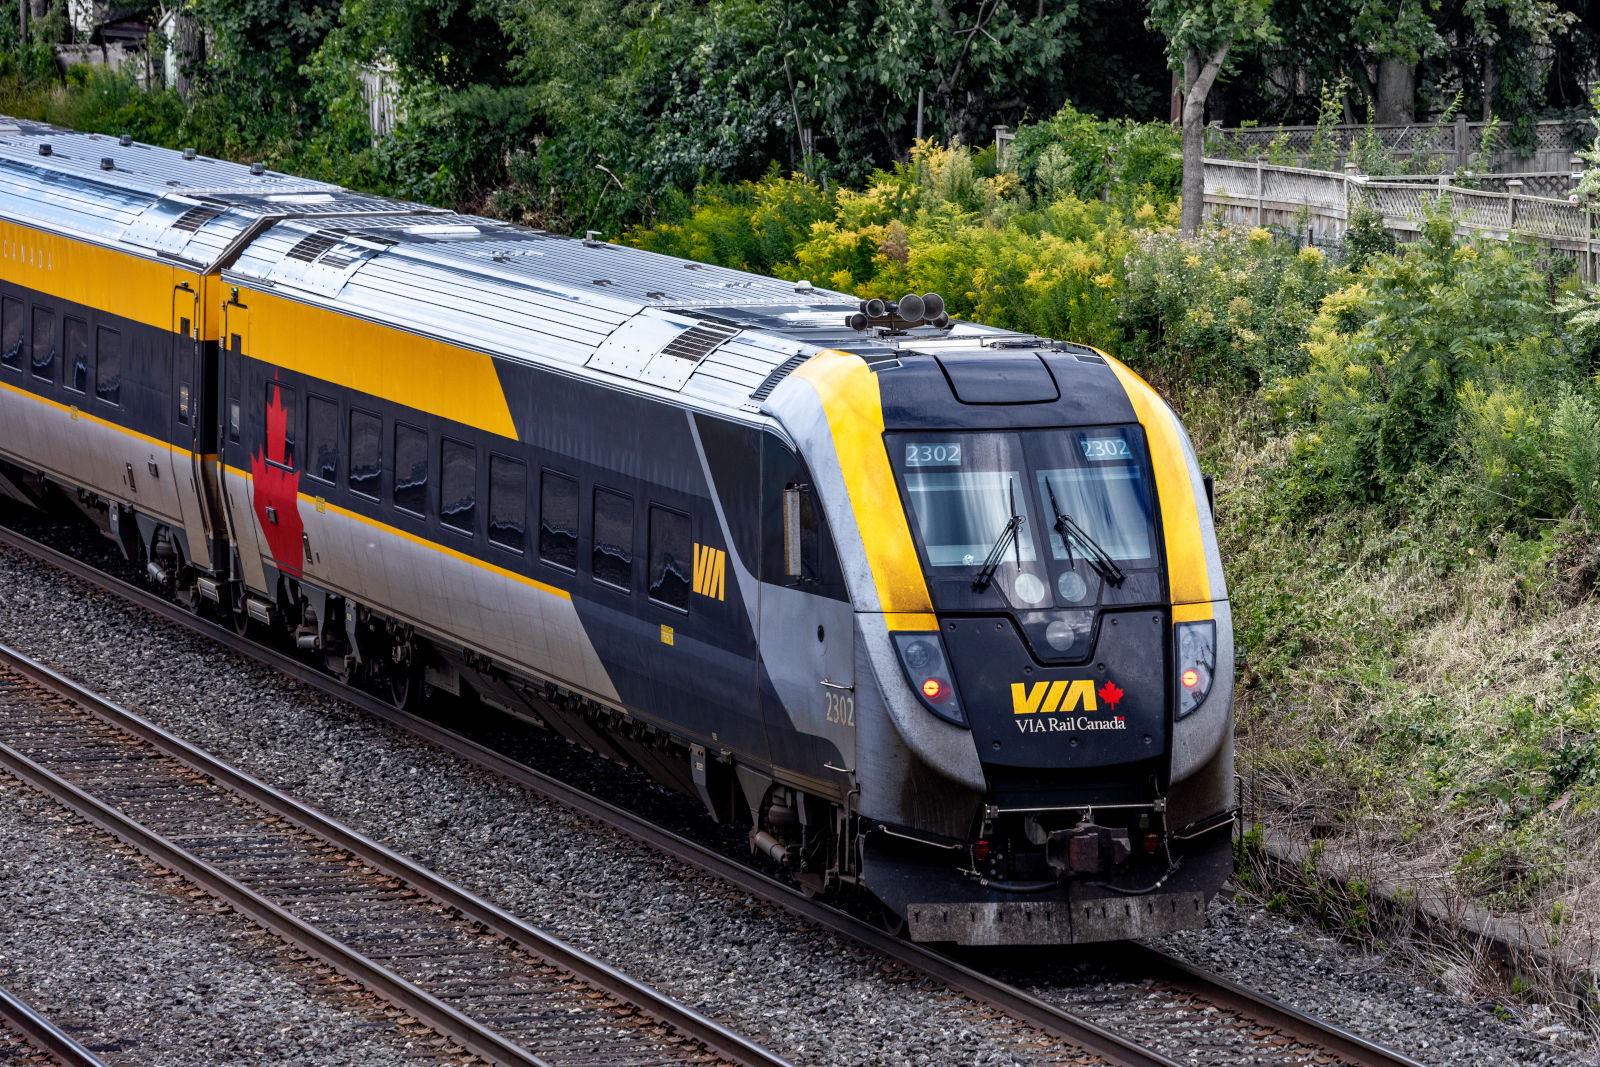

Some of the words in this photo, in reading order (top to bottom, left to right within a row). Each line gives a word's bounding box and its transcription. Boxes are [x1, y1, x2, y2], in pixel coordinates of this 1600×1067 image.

[3, 239, 52, 272] CANADA
[906, 445, 961, 462] 2302
[1083, 439, 1130, 457] 2302
[692, 542, 726, 602] VIA
[825, 691, 855, 727] 2302
[1010, 679, 1098, 715] VIA
[1015, 718, 1047, 733] VIA
[1048, 717, 1076, 732] Rail
[1076, 716, 1127, 731] Canada
